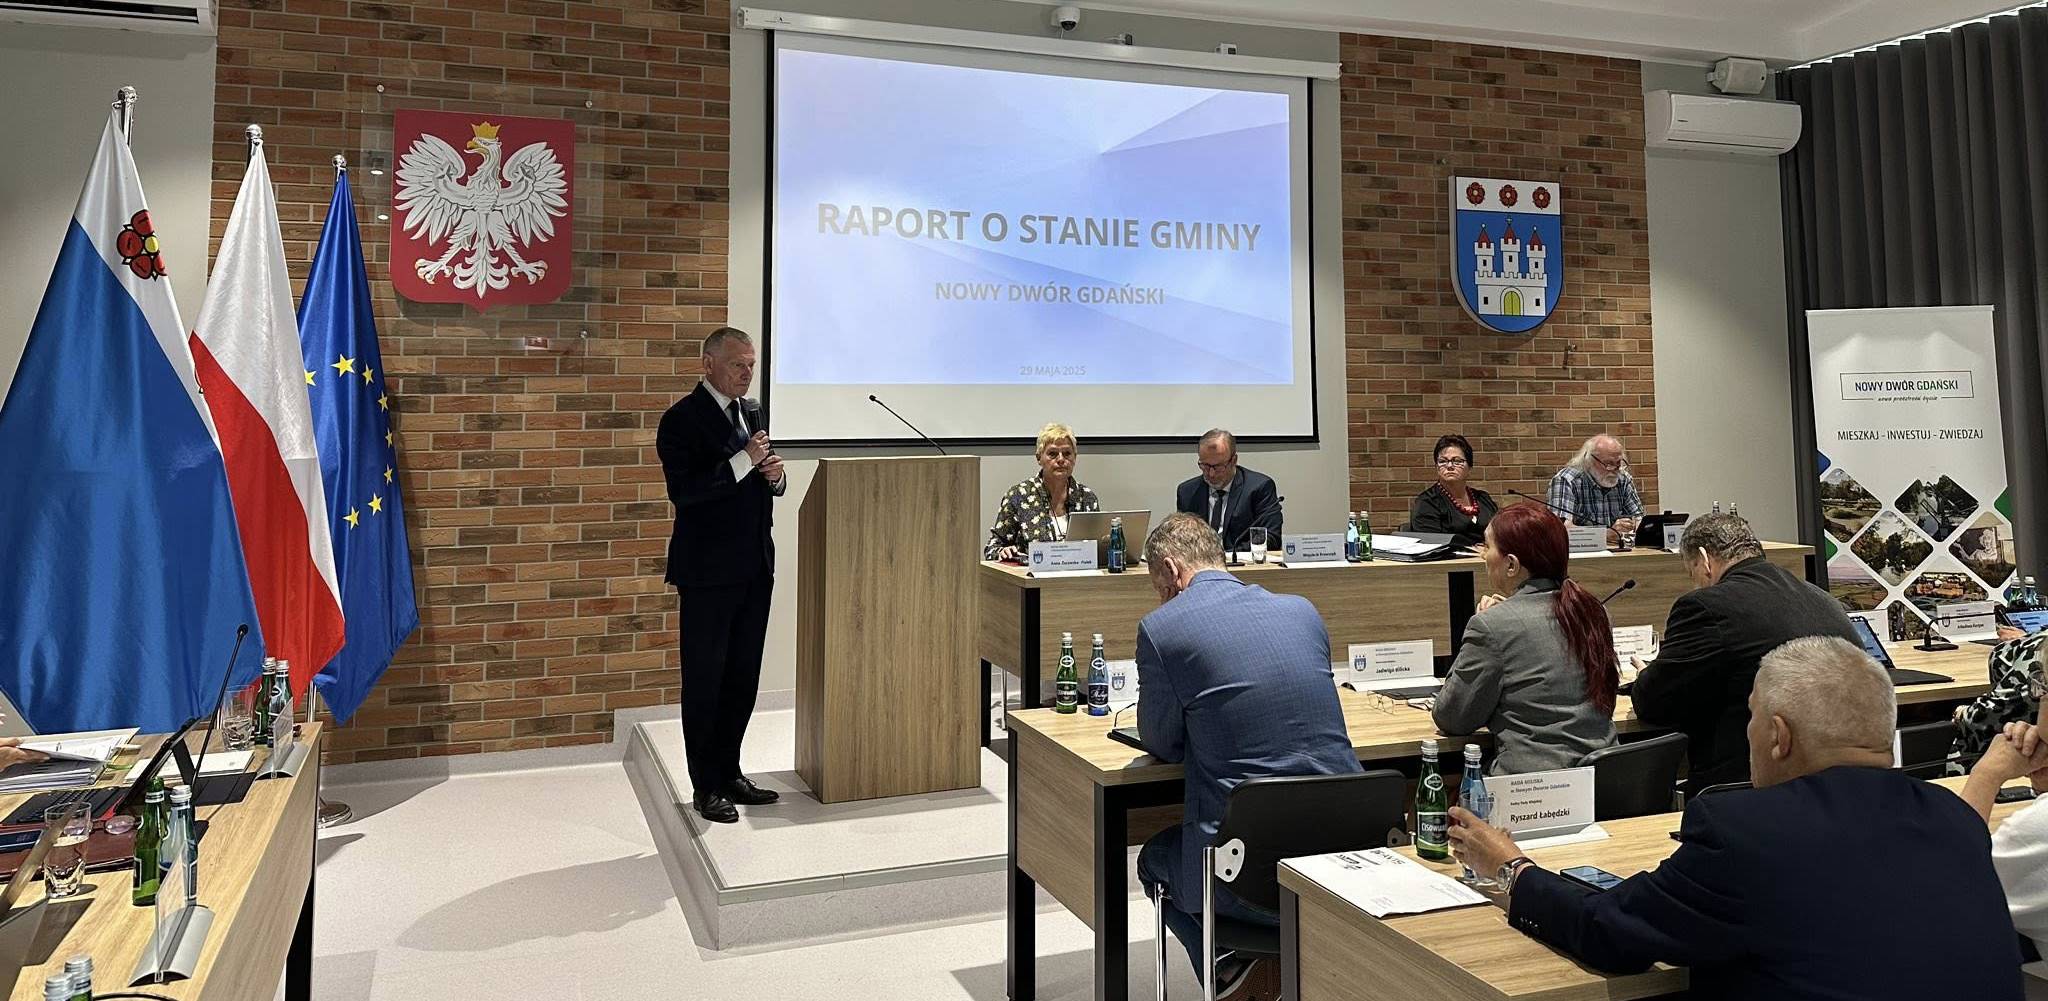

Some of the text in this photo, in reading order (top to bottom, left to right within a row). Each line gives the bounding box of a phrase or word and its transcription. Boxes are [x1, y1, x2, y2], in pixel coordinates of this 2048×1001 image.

[818, 203, 1261, 251] RAPORT O STANIE GMINY
[935, 281, 1164, 305] NOWY DWÓR GDAŃSKI
[1020, 366, 1086, 377] 29 MAJA 2025
[1855, 379, 1958, 392] NOWY DWÓR GDAŃSKI
[1837, 430, 1879, 441] MIESZKAJ
[1887, 430, 1931, 440] INWESTUJ
[1939, 429, 1984, 440] ZWIEDZAJ
[1510, 807, 1570, 824] Ryszard Łabędzki
